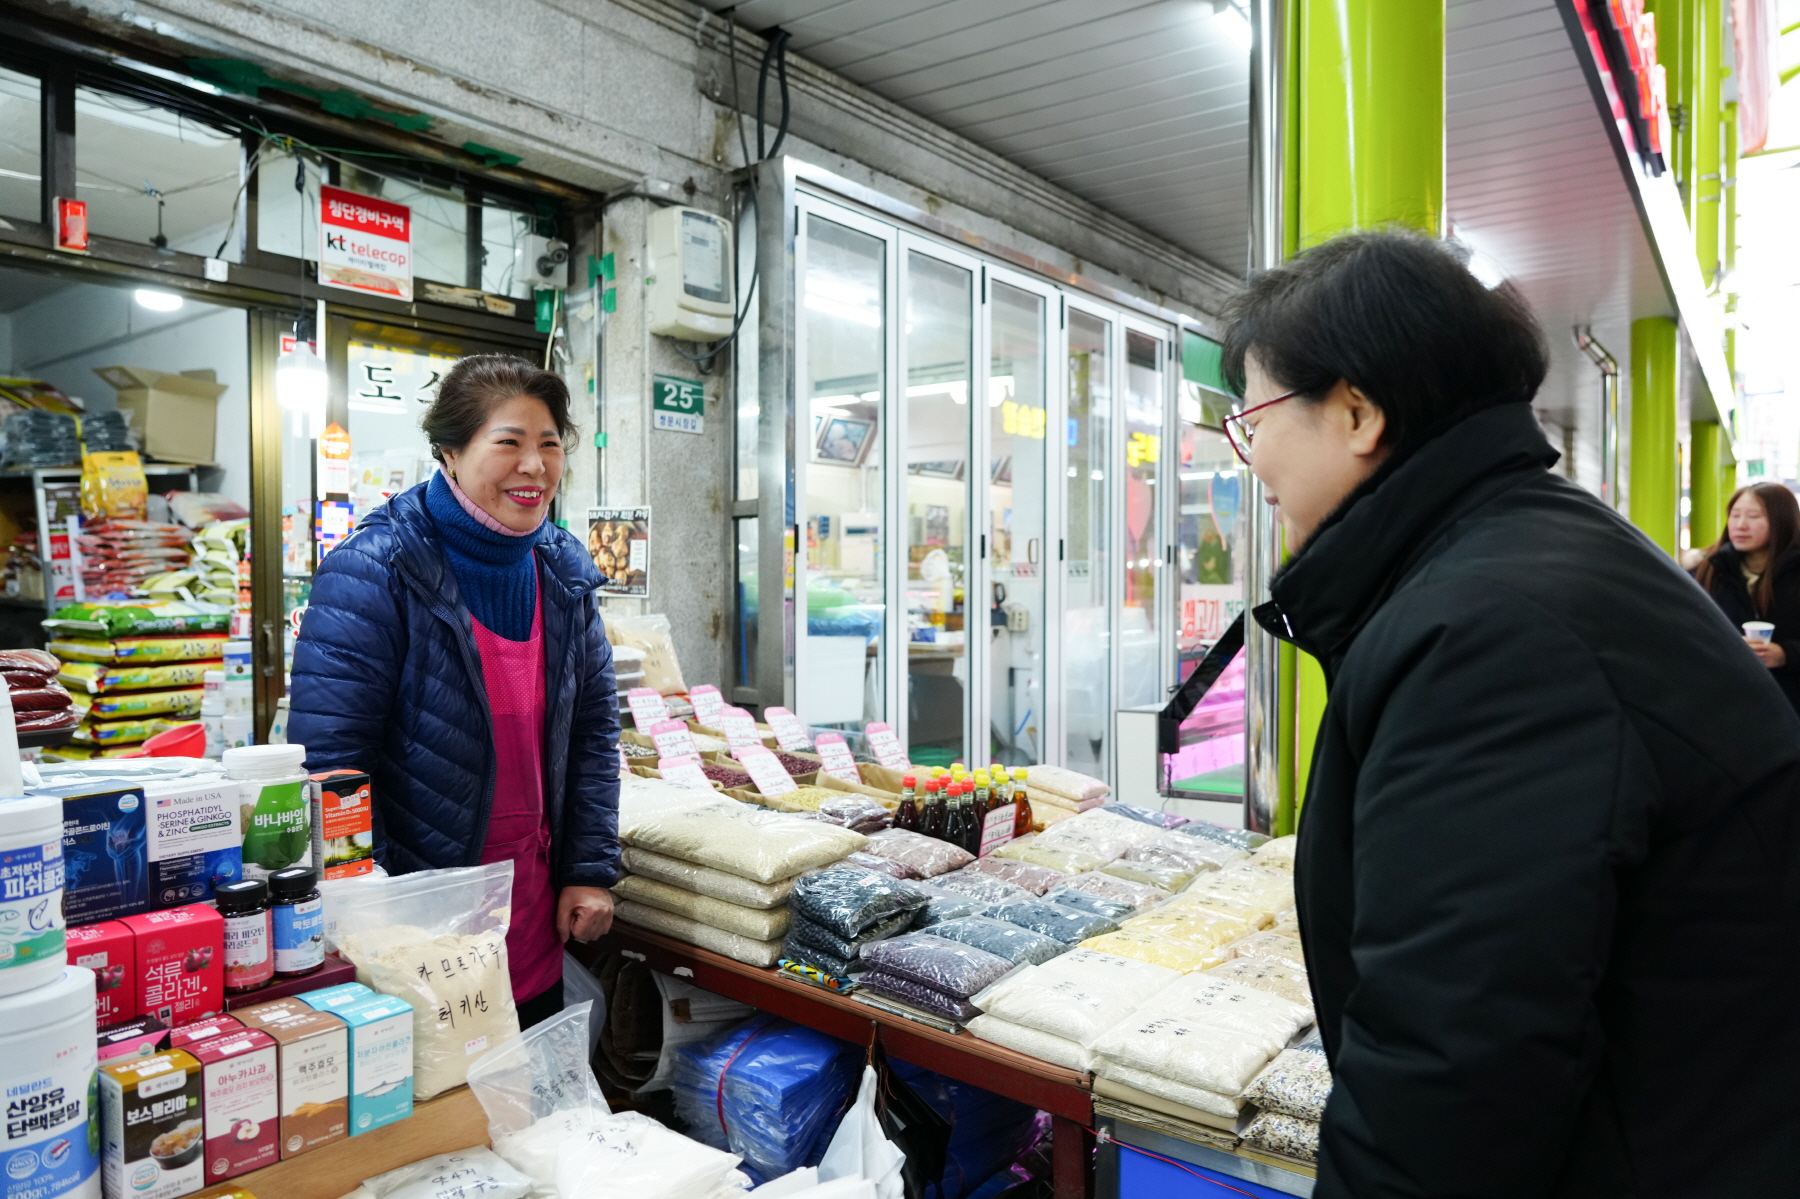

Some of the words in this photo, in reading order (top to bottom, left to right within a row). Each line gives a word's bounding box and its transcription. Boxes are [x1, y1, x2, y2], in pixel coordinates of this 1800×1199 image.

[328, 199, 405, 233] 첨단경비구역
[327, 232, 346, 252] kt
[351, 241, 406, 267] telecop
[663, 383, 694, 410] 25
[1183, 599, 1219, 638] 생고기
[173, 797, 194, 806] Made
[204, 792, 222, 801] USA
[157, 804, 223, 821] PHOSPHATIDYL
[197, 811, 232, 824] GINKGO
[254, 807, 304, 828] 바나바잎
[325, 810, 345, 819] Vitamin
[158, 830, 164, 838] &
[166, 826, 188, 837] ZINC
[0, 860, 43, 879] 초저분자
[242, 926, 265, 940] 비오틴
[145, 961, 182, 984] 석류
[145, 975, 200, 1006] 콜라겐
[175, 998, 194, 1013] 젤리
[218, 1063, 267, 1086] 아누카사과
[299, 1056, 335, 1075] 맥주효모
[6, 1076, 53, 1098] 네덜란드
[6, 1087, 66, 1119] 산양유
[126, 1094, 188, 1126] 보스웰리아
[7, 1099, 81, 1140] 단백분말
